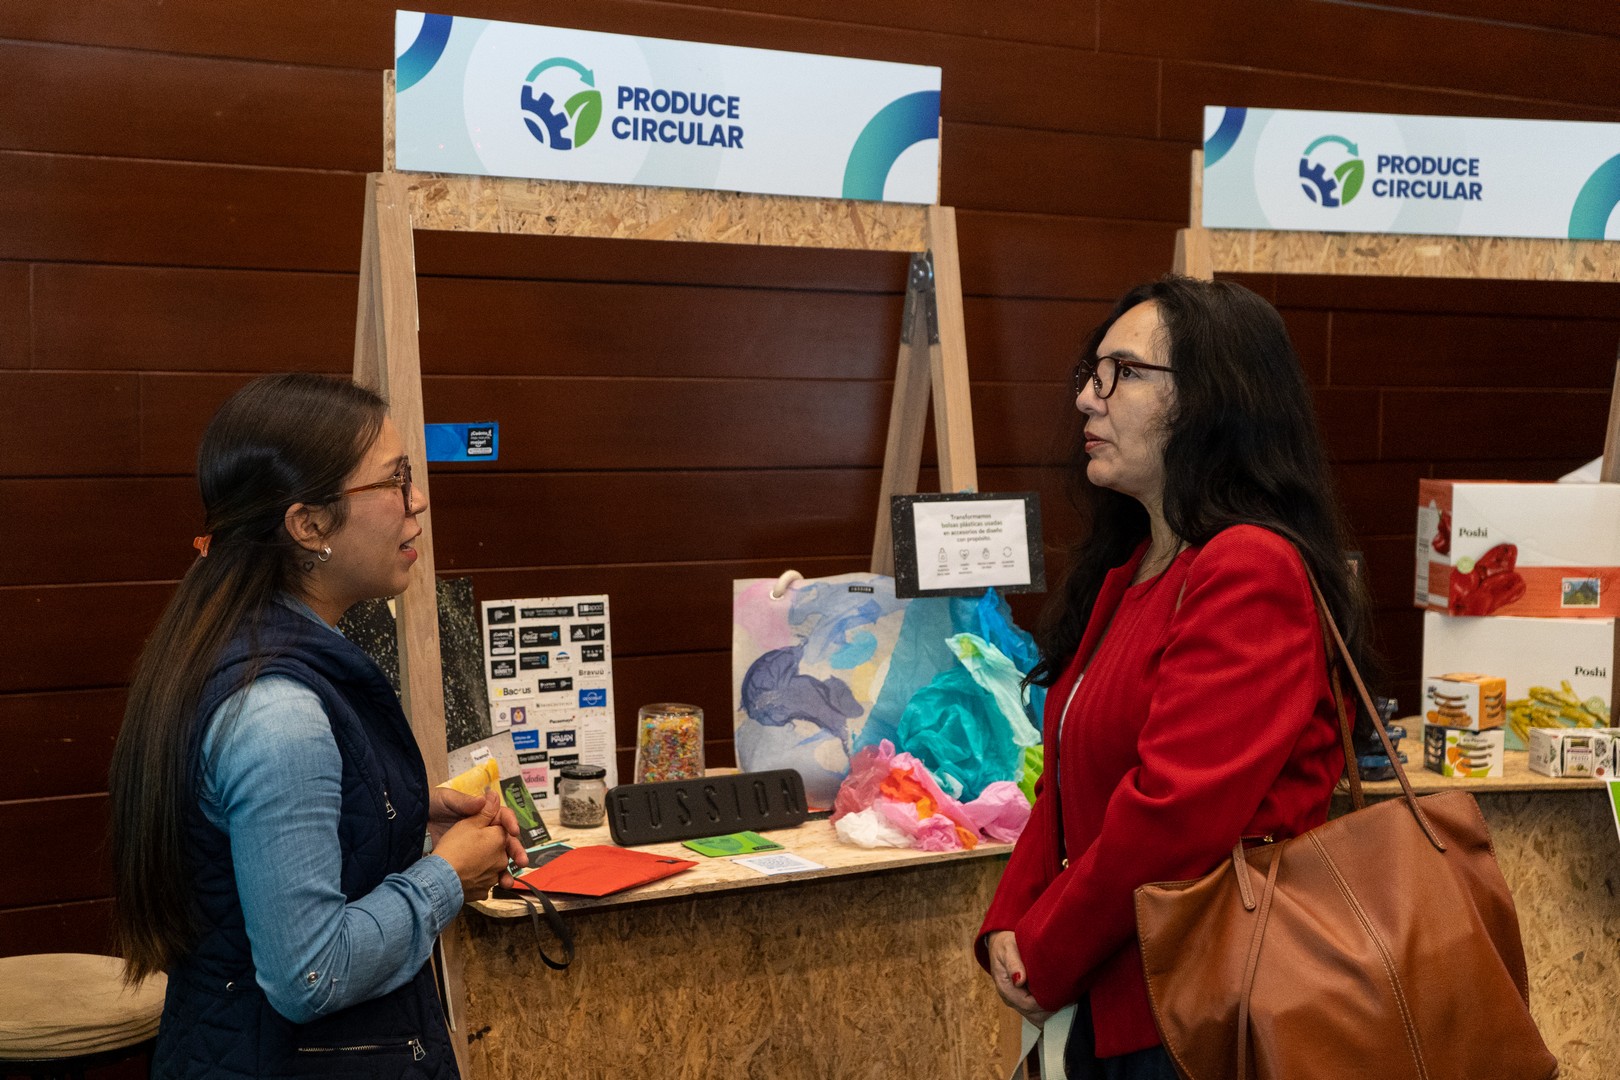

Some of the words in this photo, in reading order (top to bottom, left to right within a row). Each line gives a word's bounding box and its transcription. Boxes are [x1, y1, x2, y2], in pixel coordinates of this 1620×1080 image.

[617, 85, 740, 119] PRODUCE
[611, 115, 744, 149] CIRCULAR
[1377, 154, 1480, 177] PRODUCE
[1372, 179, 1483, 201] CIRCULAR
[960, 521, 983, 529] plásticas
[1459, 527, 1488, 538] Poshi
[1574, 666, 1606, 678] Poshi
[617, 776, 800, 832] FUSSION
